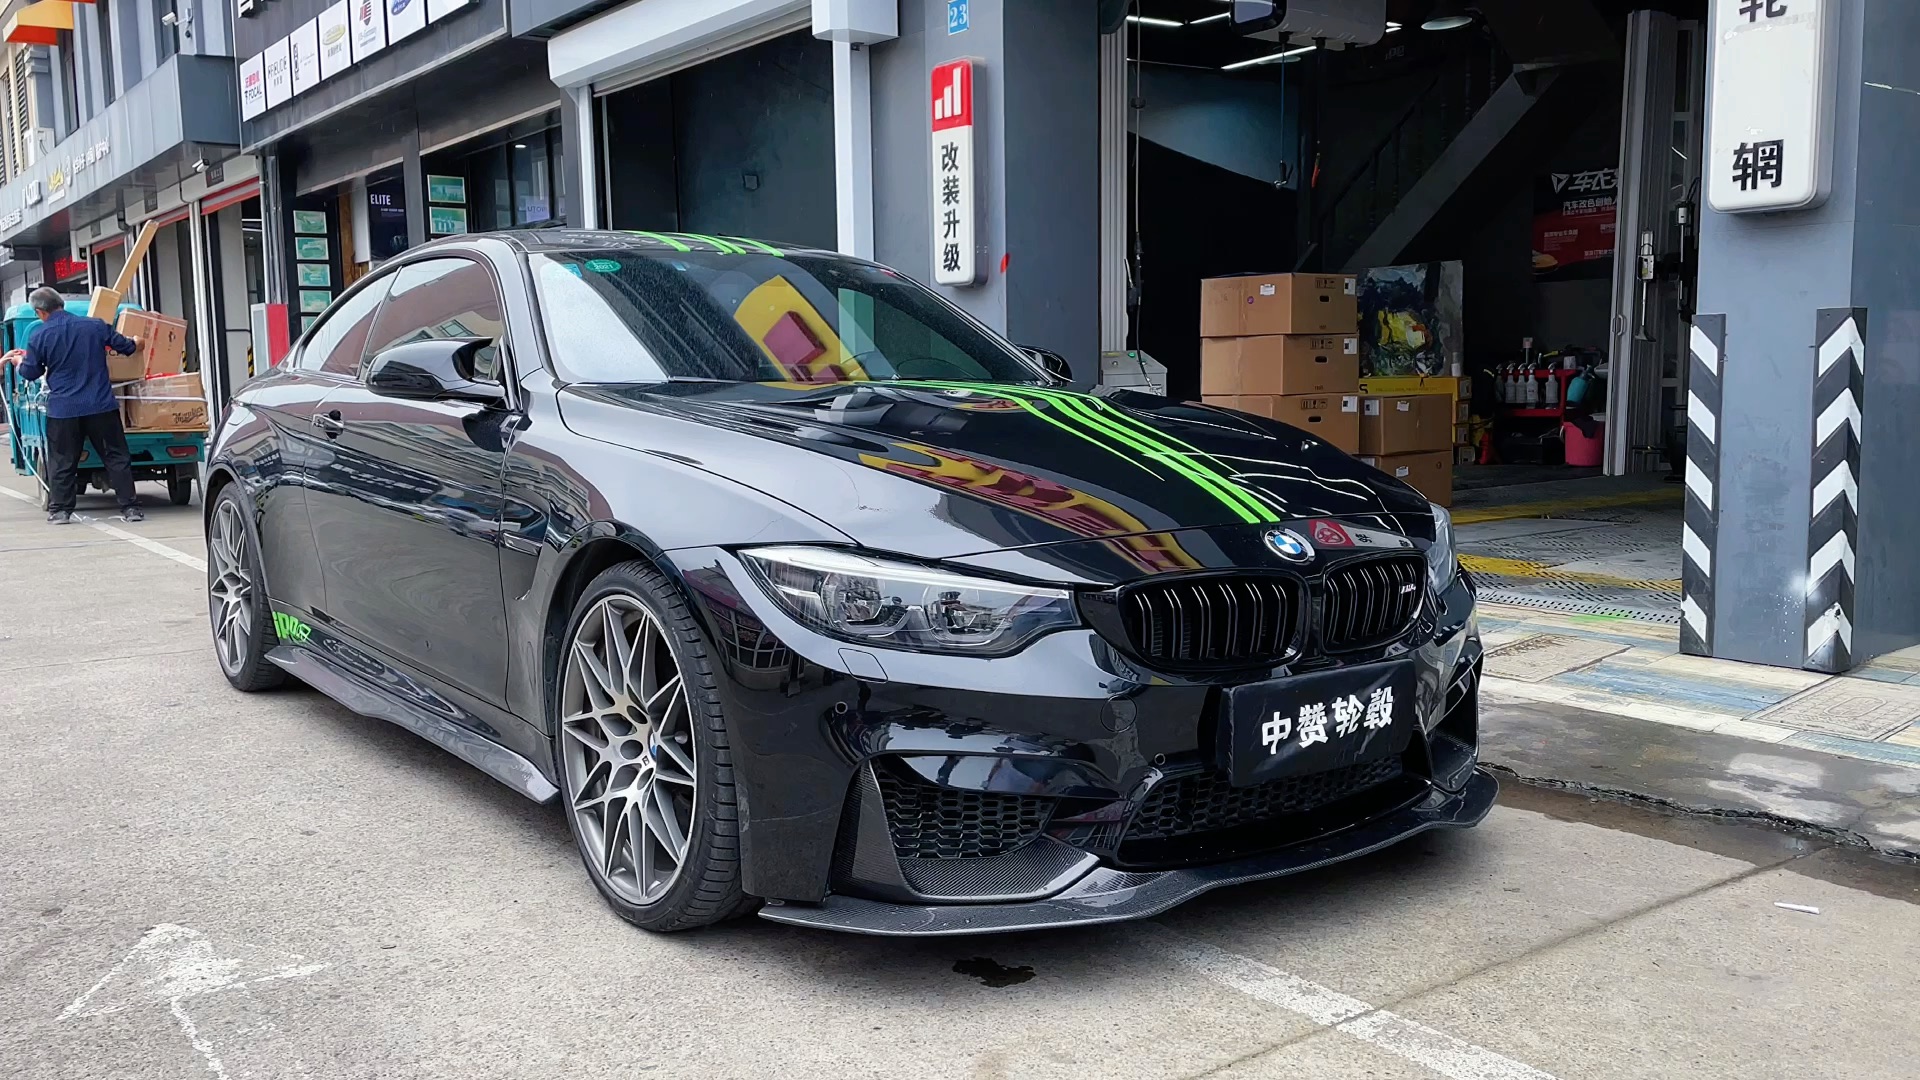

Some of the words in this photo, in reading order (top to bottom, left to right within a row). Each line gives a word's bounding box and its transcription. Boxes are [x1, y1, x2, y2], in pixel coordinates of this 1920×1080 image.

[950, 4, 967, 27] 23
[370, 194, 391, 205] ELITE
[941, 141, 961, 273] 改装升级
[1261, 685, 1395, 756] 中赞轮毂
